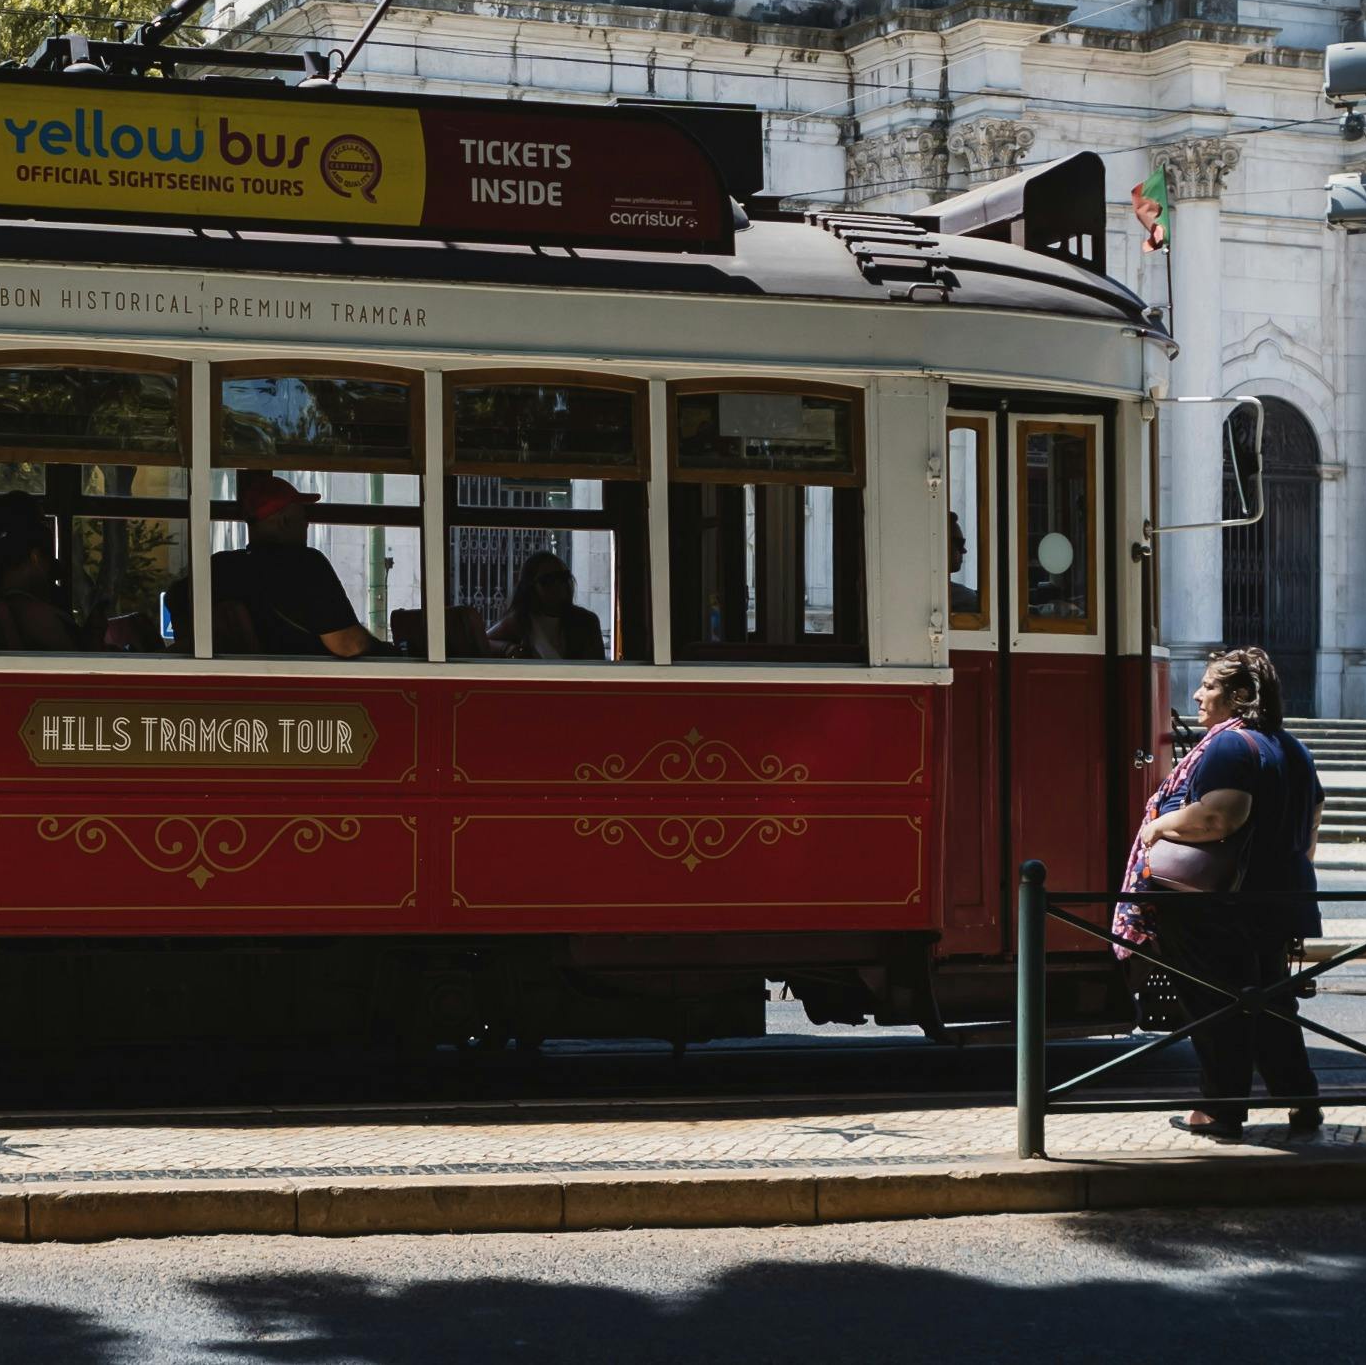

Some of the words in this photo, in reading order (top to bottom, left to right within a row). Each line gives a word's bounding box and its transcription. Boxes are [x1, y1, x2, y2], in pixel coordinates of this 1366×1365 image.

[218, 117, 311, 169] bus
[459, 138, 573, 169] TICKETS
[16, 164, 103, 186] OFFICIAL
[108, 169, 235, 193] SIGHTSEEING
[240, 177, 305, 197] TOURS
[471, 177, 563, 207] INSIDE
[610, 210, 684, 227] carristur
[60, 289, 194, 315] HISTORICAL
[213, 297, 313, 321] PREMIUM
[331, 302, 428, 328] TRAMCAR
[41, 715, 133, 752] HILLS
[140, 716, 269, 754] TRAMCAR
[278, 718, 354, 755] TOUR
